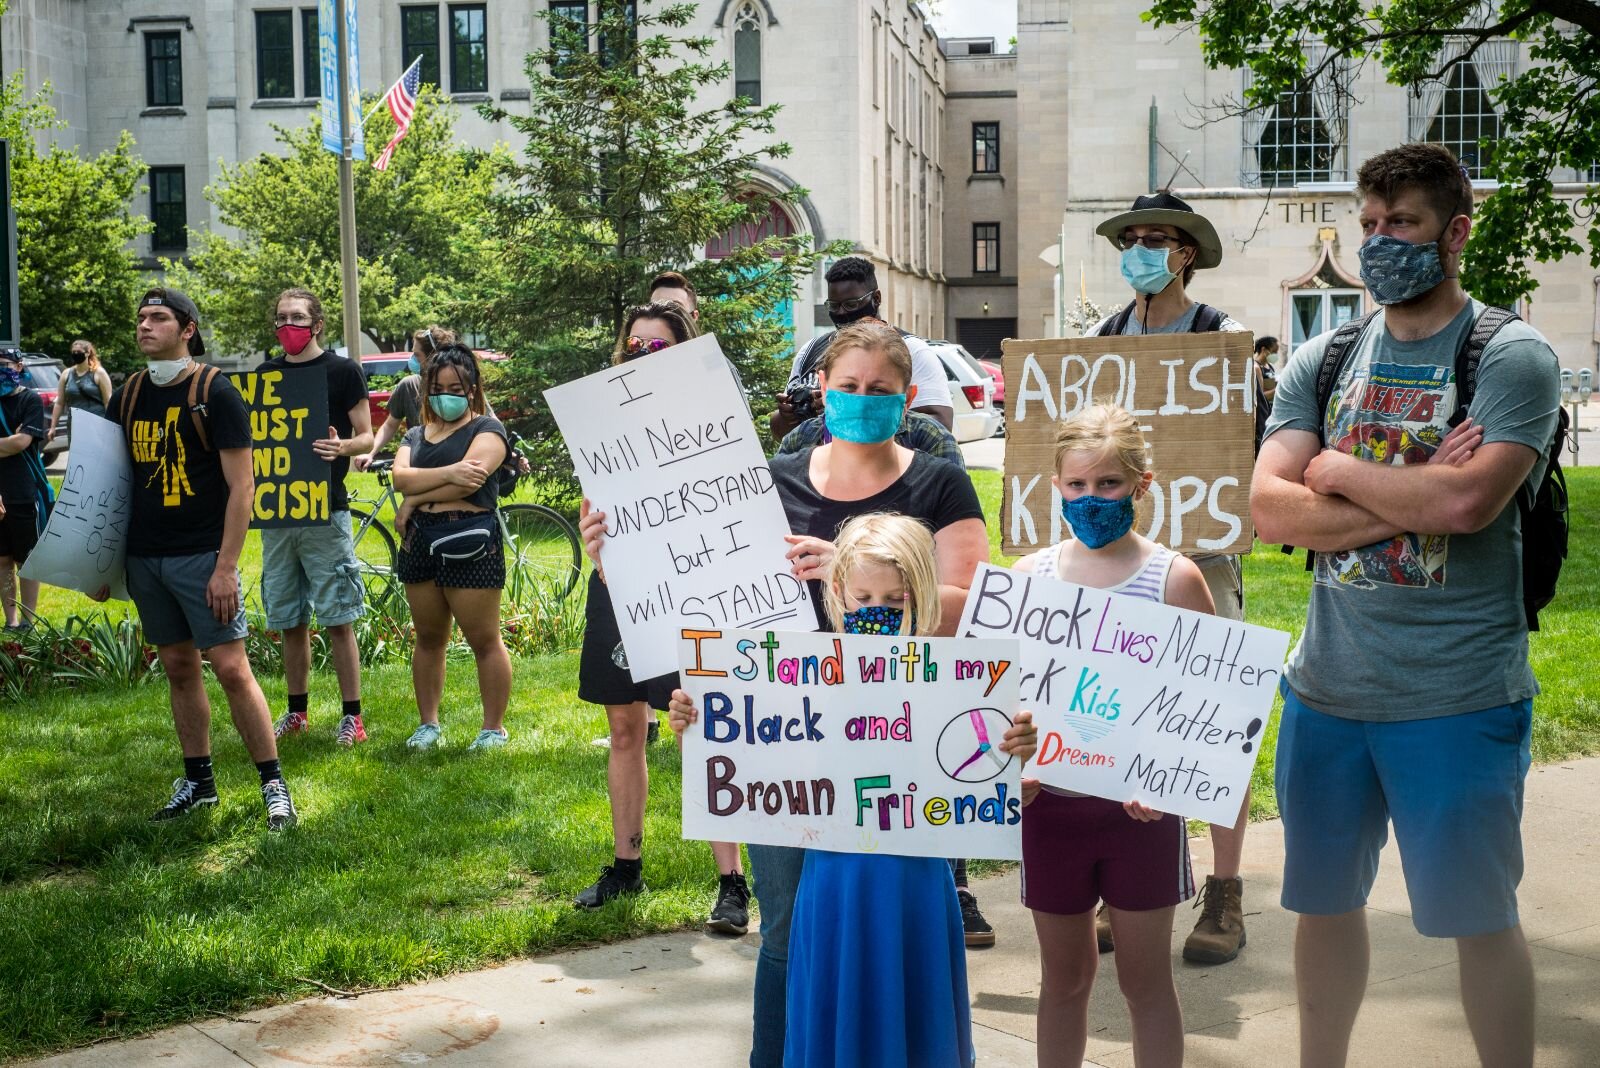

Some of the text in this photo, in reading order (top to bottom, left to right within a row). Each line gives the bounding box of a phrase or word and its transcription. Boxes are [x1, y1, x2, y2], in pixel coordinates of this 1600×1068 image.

[1278, 202, 1337, 223] THE
[230, 371, 283, 406] WE
[608, 370, 653, 406] I
[1014, 353, 1253, 421] ABOLISH
[251, 408, 309, 441] UST
[580, 416, 735, 475] Will Never
[252, 446, 291, 478] ND
[44, 464, 84, 542] THIS
[75, 495, 94, 522] IS
[87, 487, 114, 555] OUR
[97, 470, 132, 574] CHANCE
[250, 481, 329, 521] CISM
[597, 466, 775, 538] UNDERSTAND
[668, 520, 750, 576] but I
[627, 581, 673, 625] will
[971, 569, 1278, 686] Black Lives Matter
[681, 629, 728, 678] I
[859, 641, 938, 683] with
[955, 659, 1011, 697] my
[702, 692, 912, 745] Black and
[1069, 666, 1122, 721] Kids
[1132, 686, 1263, 754] Matter!
[706, 755, 1022, 831] Brown Friends
[1037, 732, 1231, 802] Dreams Matter
